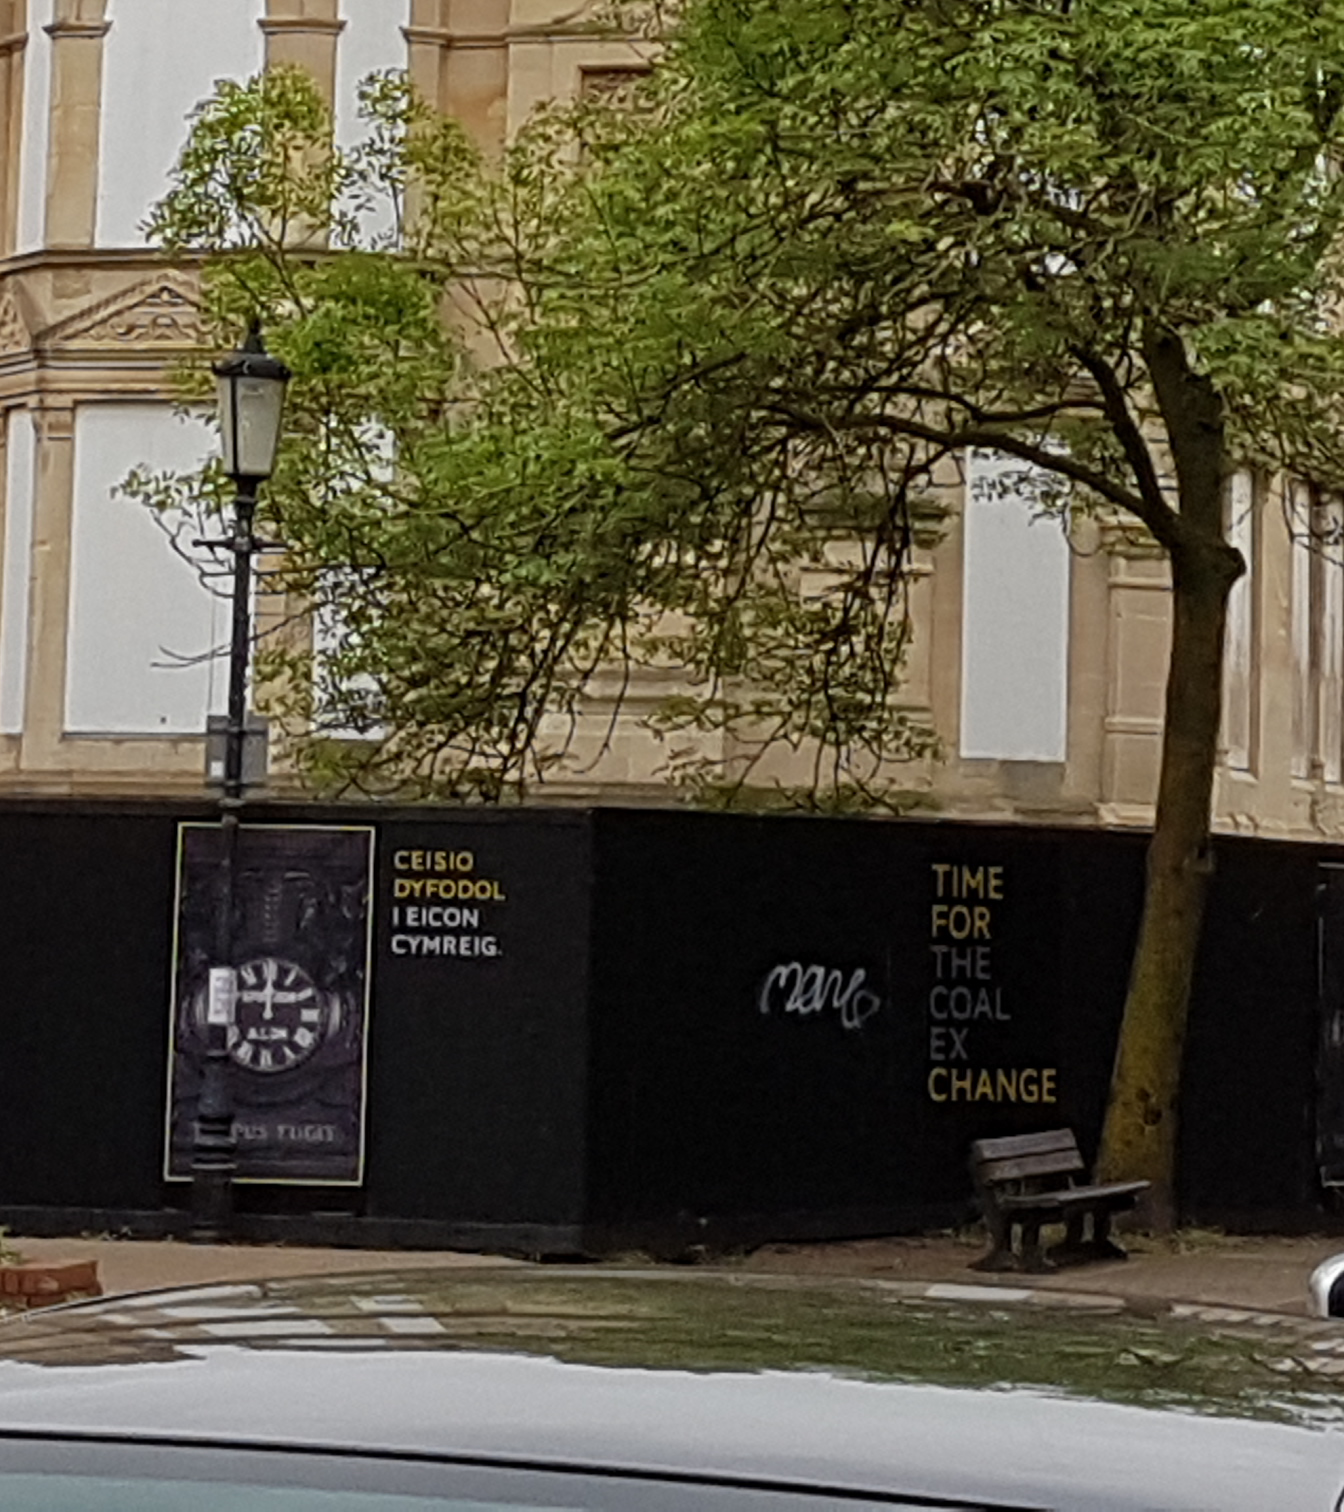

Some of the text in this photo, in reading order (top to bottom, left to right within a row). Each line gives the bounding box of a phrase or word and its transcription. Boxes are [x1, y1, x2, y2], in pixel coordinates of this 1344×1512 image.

[394, 850, 475, 872] CEISIO
[393, 878, 507, 901] DYFODOL
[931, 863, 1004, 900] TIME
[392, 906, 479, 928] I EICON
[931, 904, 992, 939] FOR
[391, 934, 504, 957] CYMREIG.
[929, 945, 992, 980] THE
[929, 986, 1012, 1021] COAL
[929, 1026, 969, 1061] EX
[927, 1066, 1057, 1104] CHANGE
